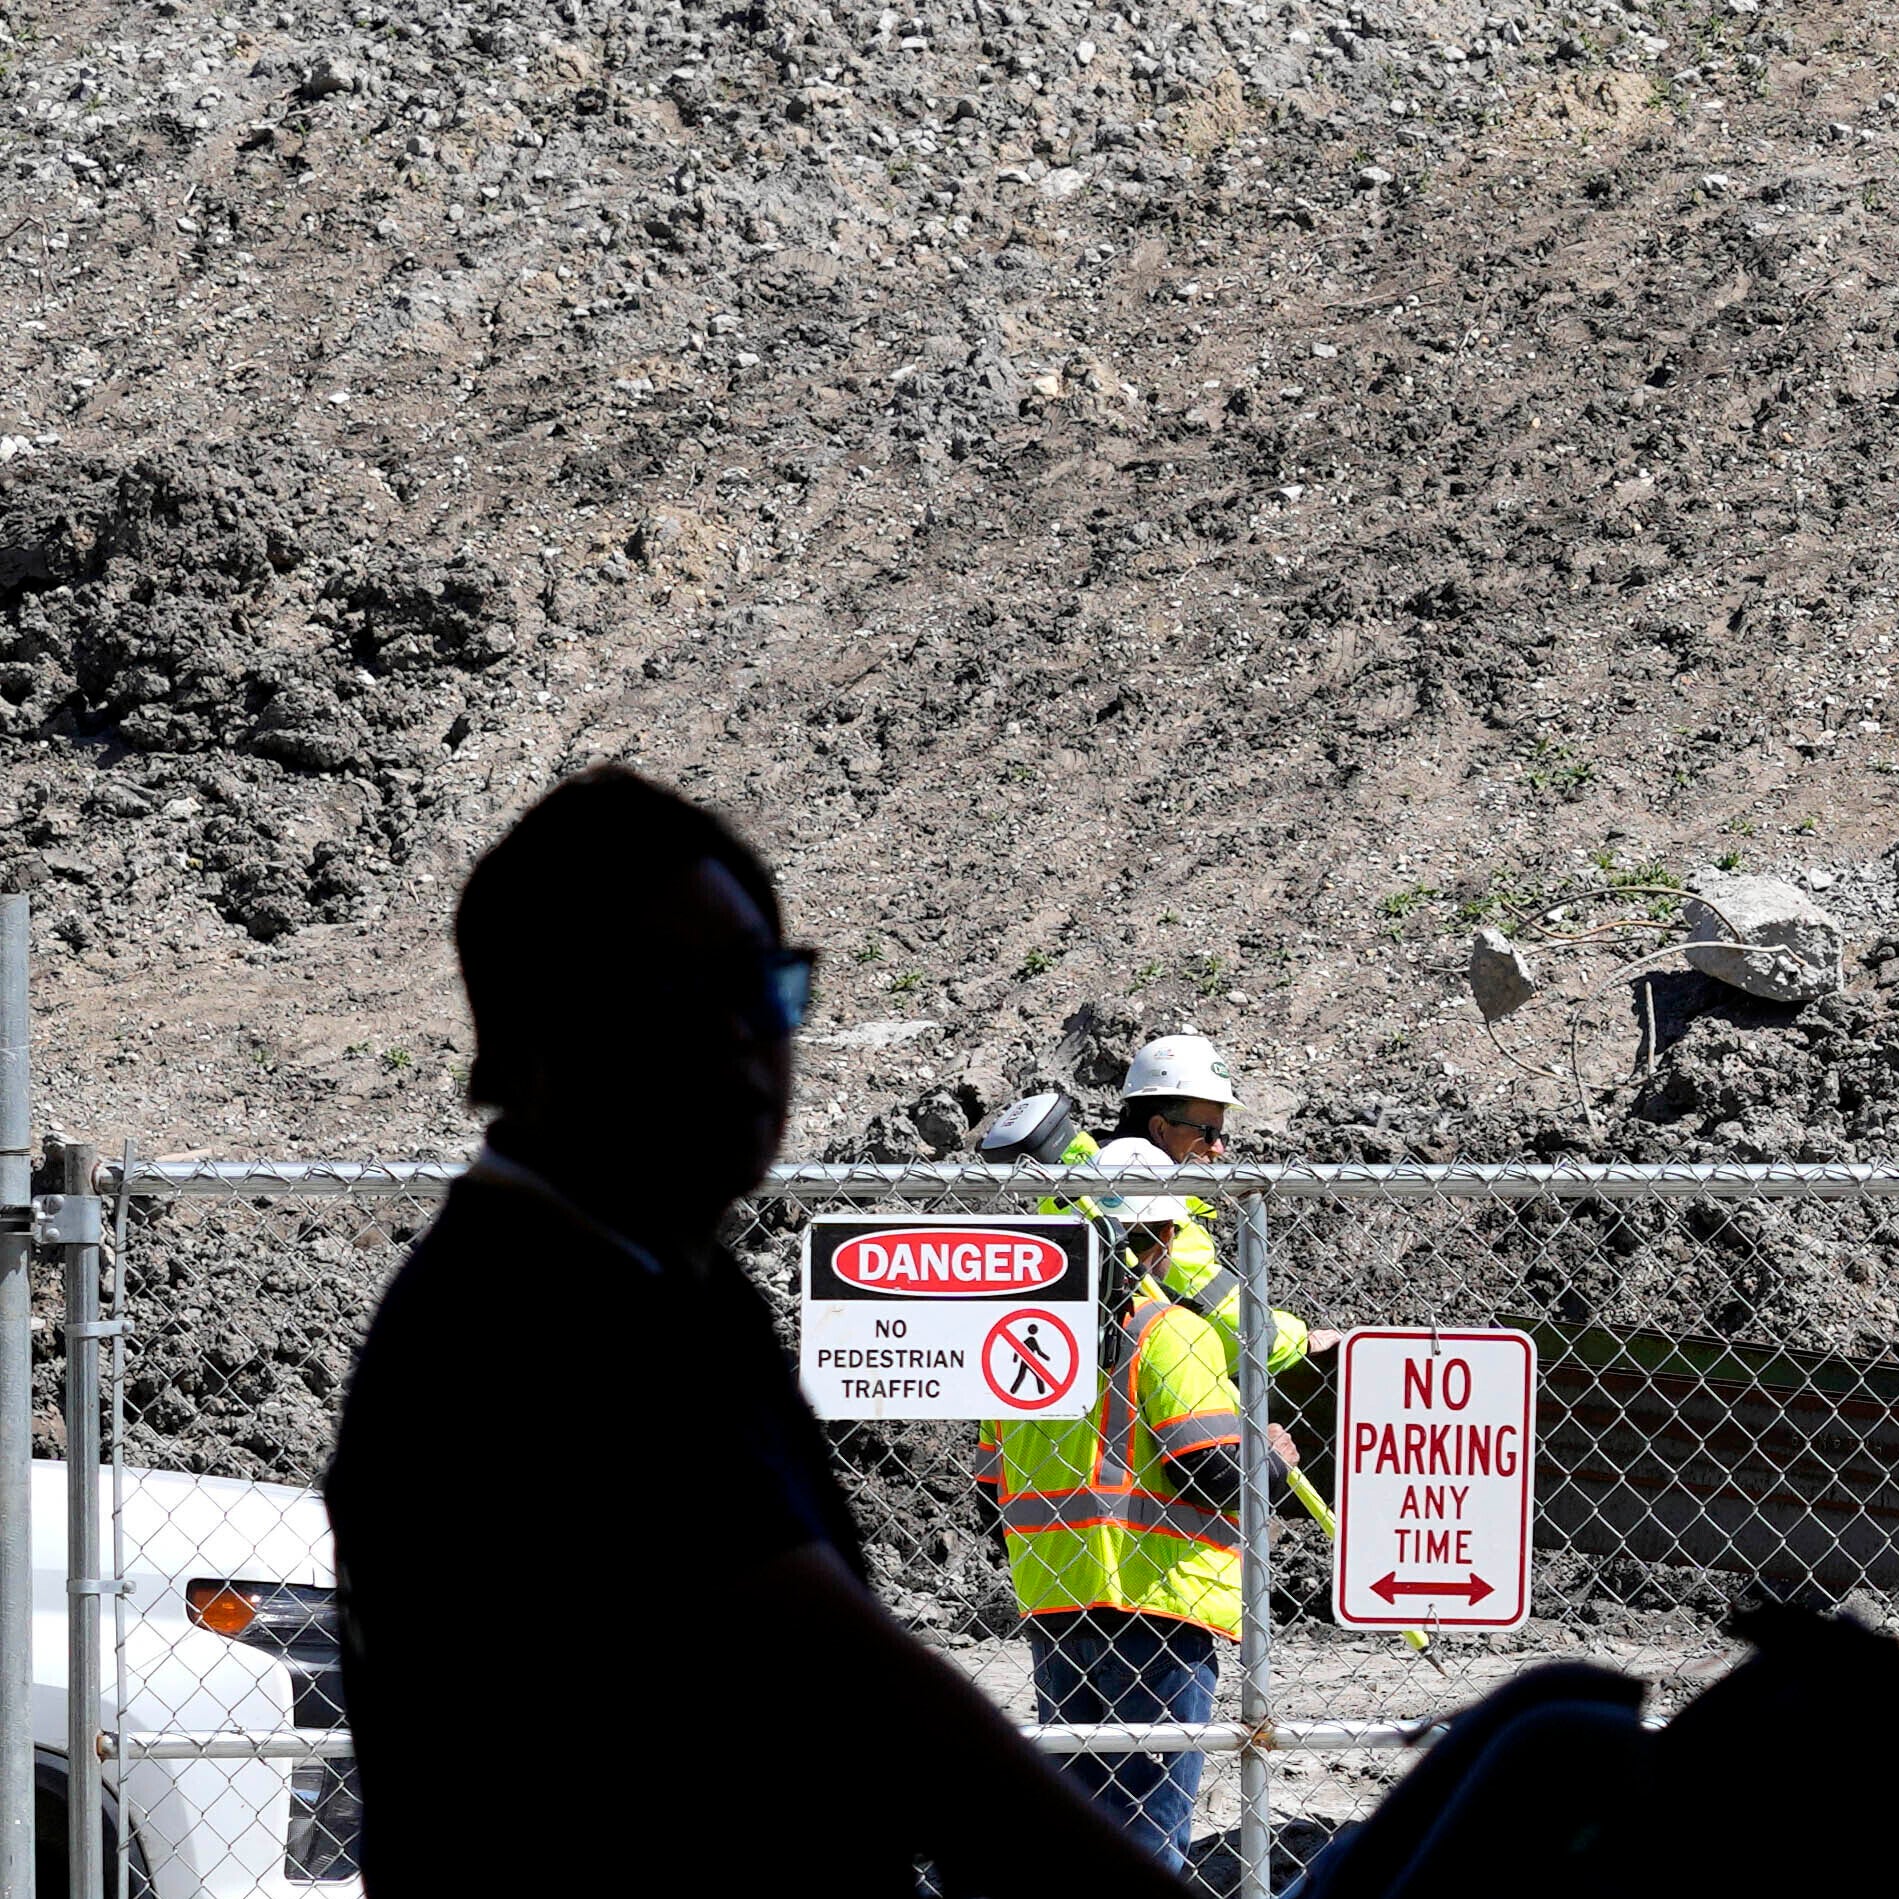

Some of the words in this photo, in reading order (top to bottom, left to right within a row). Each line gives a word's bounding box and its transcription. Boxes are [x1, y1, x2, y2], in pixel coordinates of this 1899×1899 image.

[856, 1241, 1045, 1285] DANGER
[875, 1319, 907, 1339] NO
[818, 1349, 964, 1369] PEDESTRIAN
[841, 1379, 940, 1399] TRAFFIC
[1405, 1358, 1471, 1410] NO
[1355, 1423, 1517, 1477] PARKING
[1400, 1485, 1469, 1520] ANY
[1395, 1529, 1473, 1564] TIME
